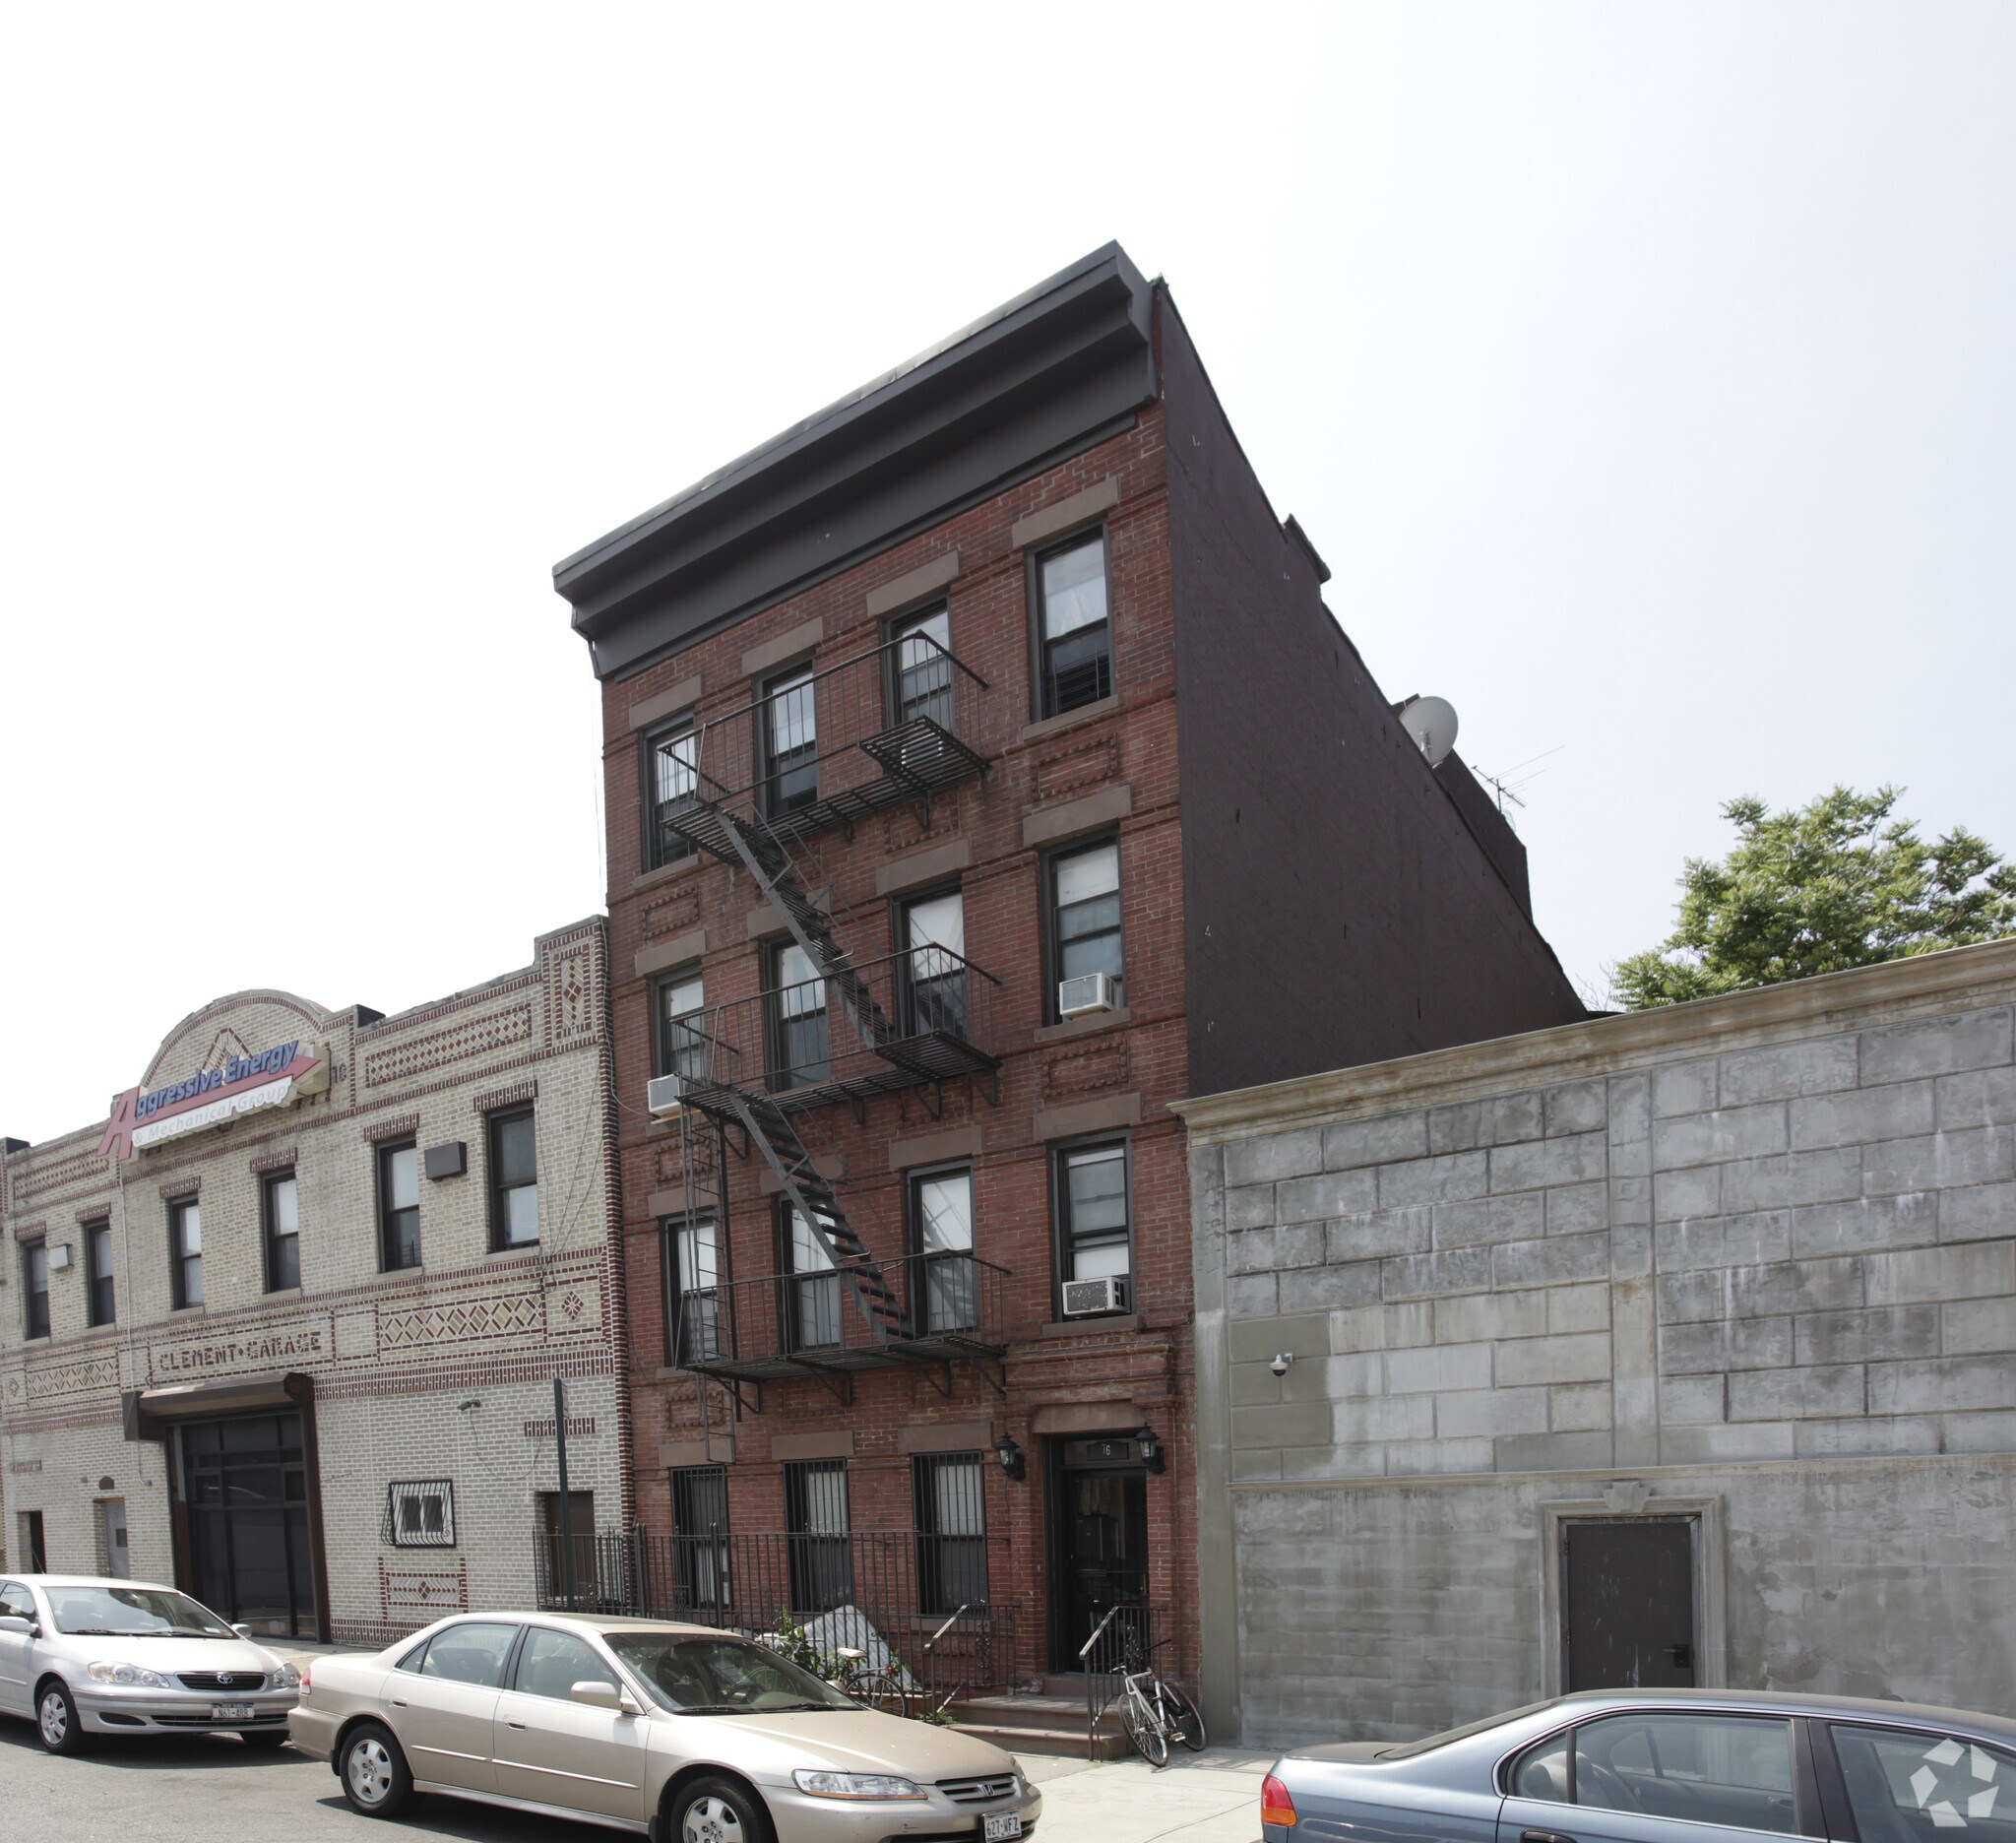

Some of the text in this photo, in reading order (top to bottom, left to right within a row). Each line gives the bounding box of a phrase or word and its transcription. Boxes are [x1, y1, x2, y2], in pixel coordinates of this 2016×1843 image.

[95, 1040, 299, 1163] Aggressive Energy
[134, 1085, 287, 1145] & Mechanical Group
[159, 1331, 321, 1371] CLEMENT GARAGE
